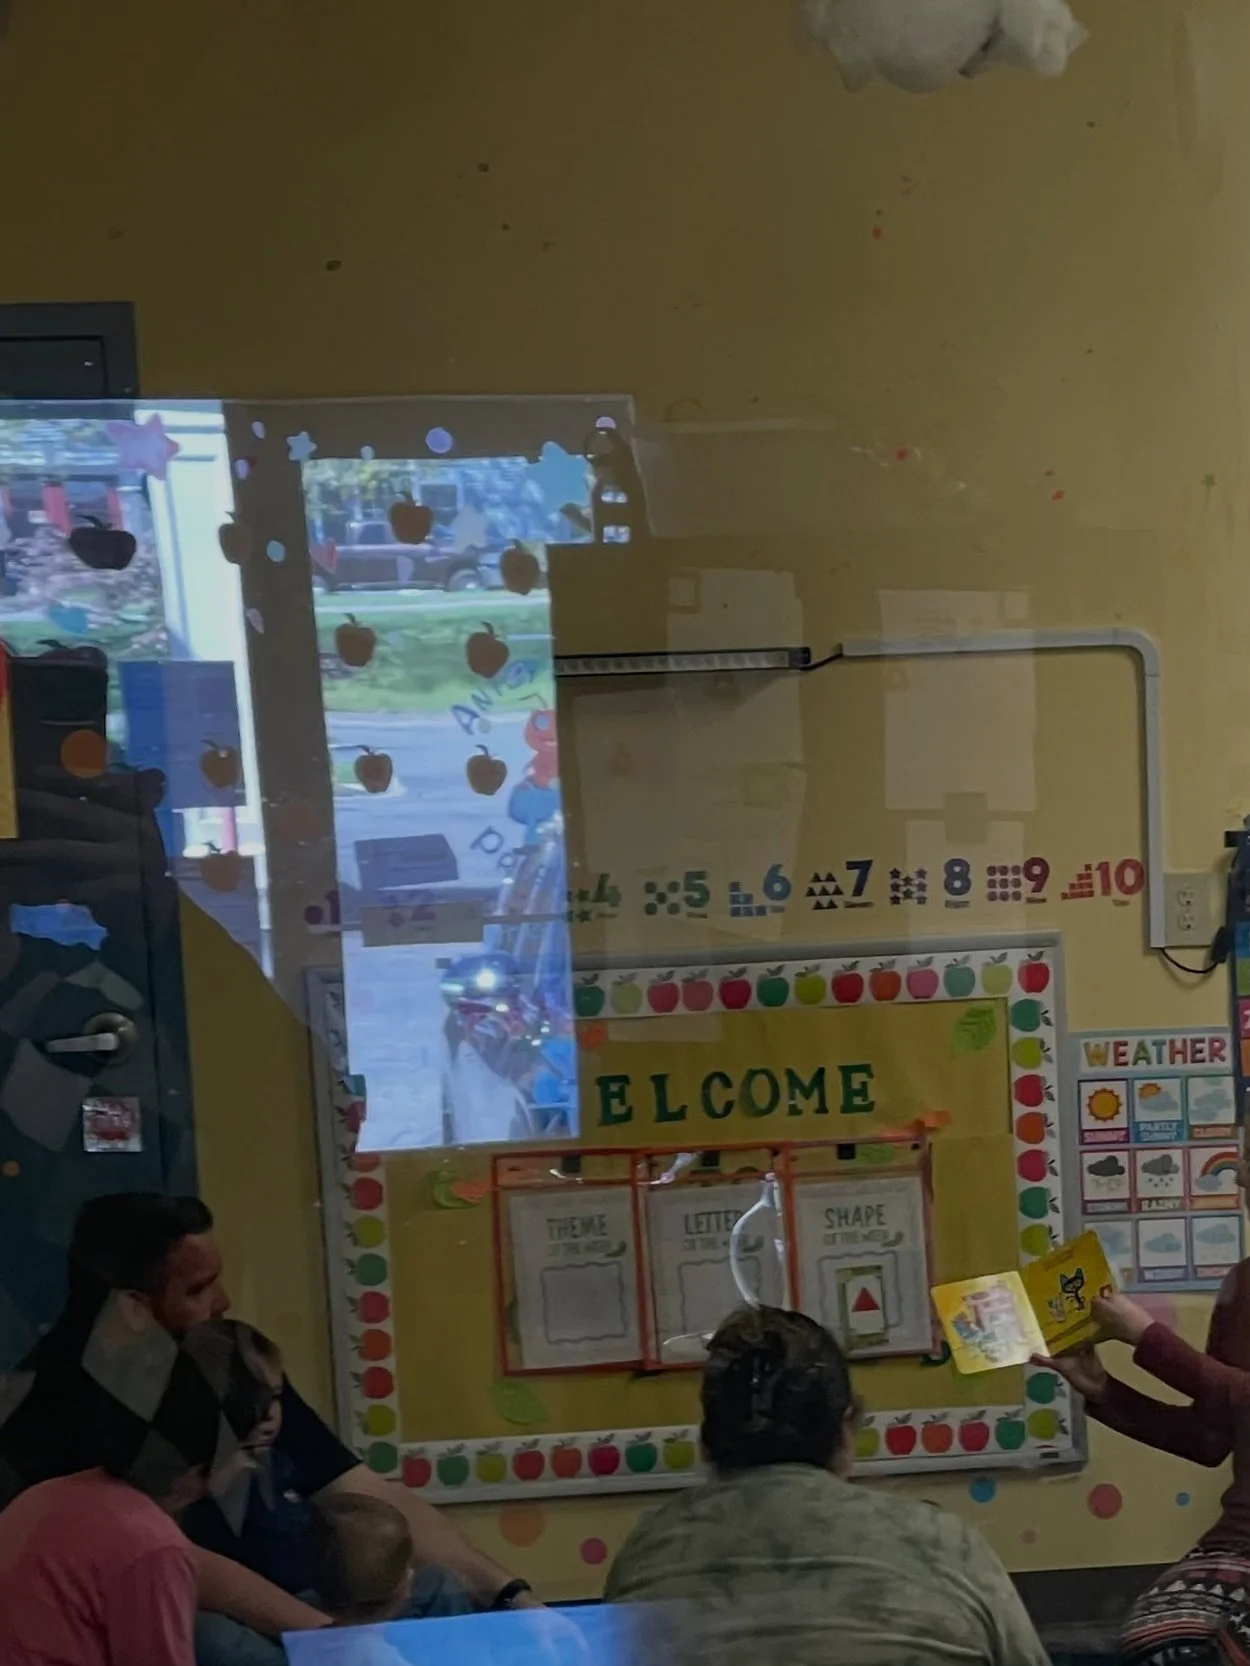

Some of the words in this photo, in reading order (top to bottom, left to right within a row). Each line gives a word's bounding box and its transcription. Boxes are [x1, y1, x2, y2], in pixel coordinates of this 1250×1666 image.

[683, 869, 710, 909] 5
[762, 863, 792, 902] 6
[845, 858, 874, 898] 7
[943, 857, 972, 897] 8
[1022, 856, 1050, 894] 9
[1095, 857, 1146, 897] 10
[1083, 1036, 1227, 1067] WEATHER
[595, 1063, 877, 1128] ELCOME
[546, 1213, 608, 1241] THEME
[823, 1203, 887, 1230] SHAPE
